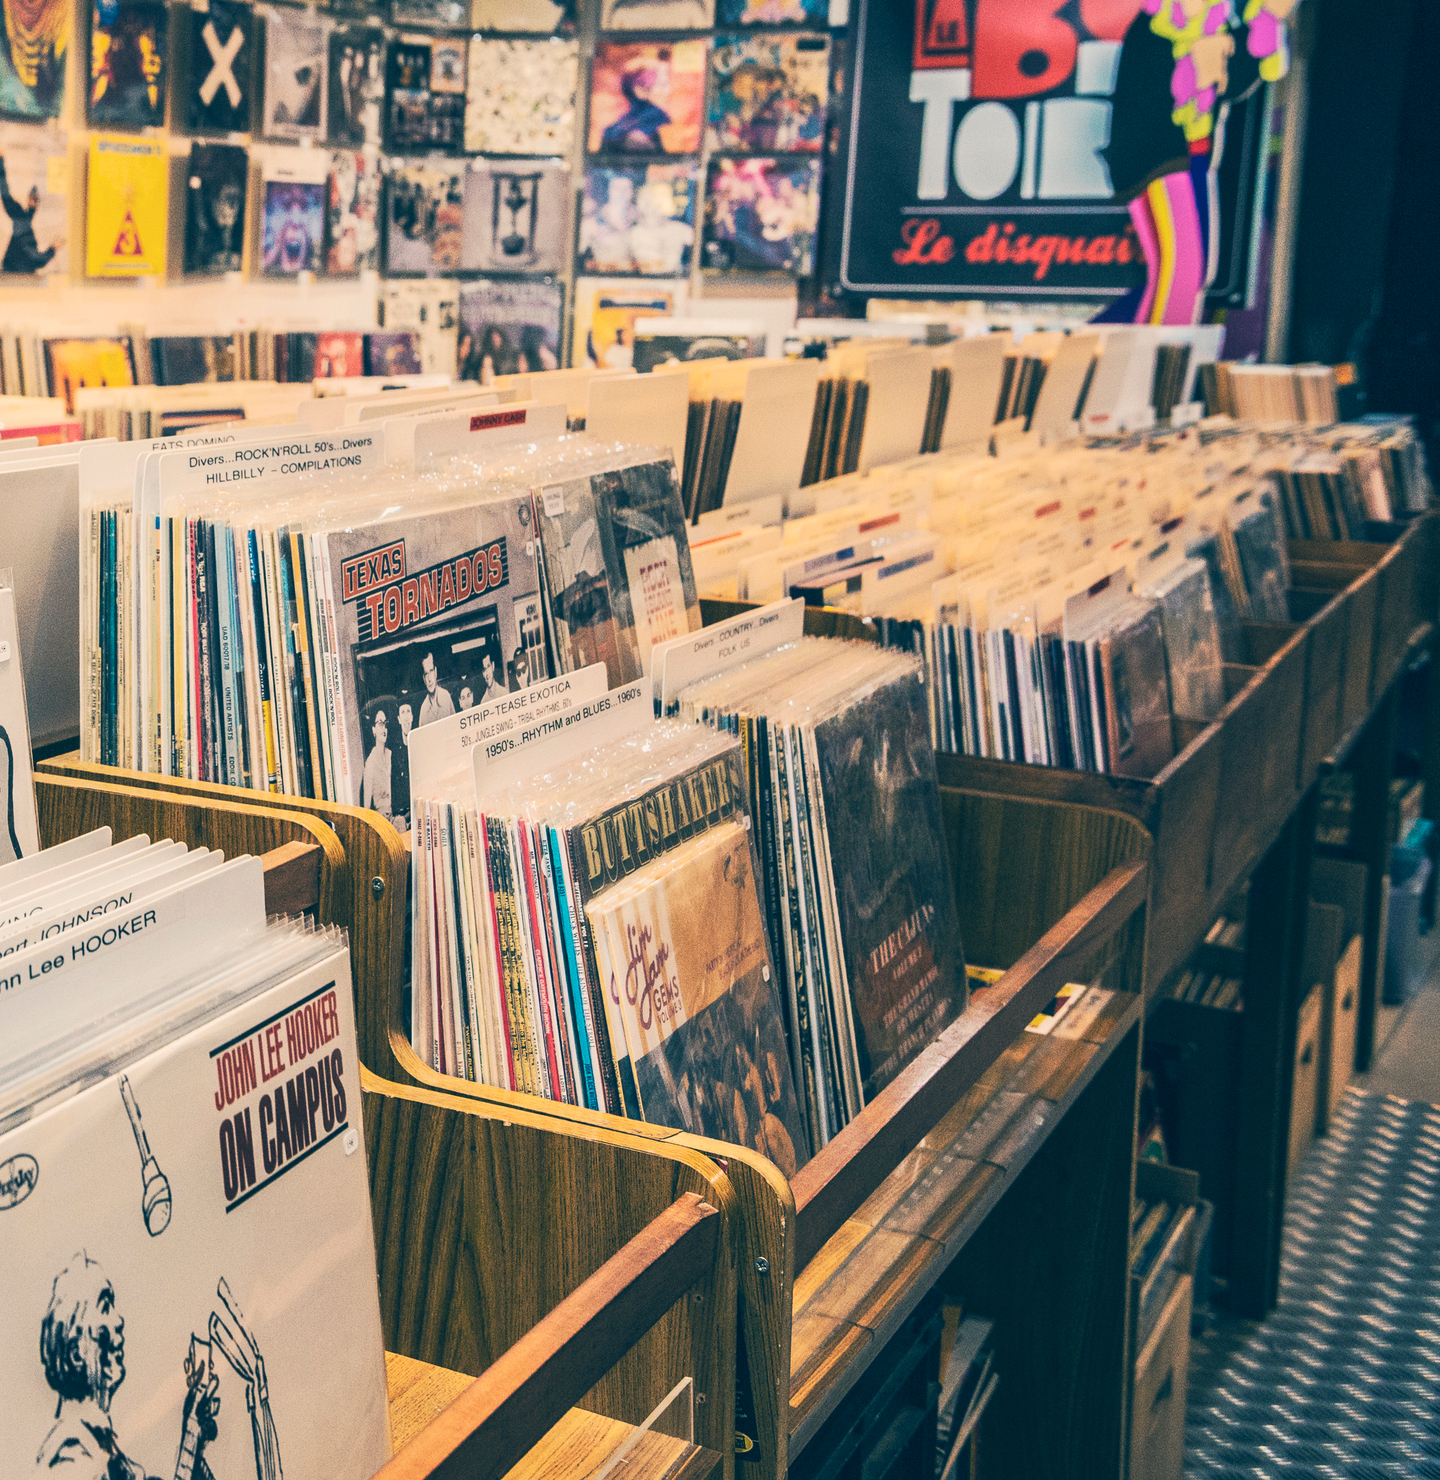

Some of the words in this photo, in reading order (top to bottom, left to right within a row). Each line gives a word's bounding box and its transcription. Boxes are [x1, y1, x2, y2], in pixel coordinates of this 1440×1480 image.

[892, 218, 955, 264] Le
[964, 222, 1140, 281] disquai
[206, 466, 265, 485] HILLBILLY
[280, 455, 362, 475] COMPILATIONS
[346, 548, 402, 595] TEXAS
[365, 543, 504, 641] TORNADOS
[221, 626, 229, 641] UAD
[324, 655, 333, 688] LOUISIANA
[225, 687, 233, 711] UNITED
[459, 694, 527, 730] STRIP-TEASE
[530, 680, 571, 704] EXOTICA
[227, 713, 235, 741] ARTISTS
[565, 710, 581, 727] and
[581, 756, 740, 893] BUTTSHAKERS
[531, 864, 540, 900] PERSONALITY
[568, 905, 579, 930] CHUCK
[28, 953, 65, 980] Lee
[71, 909, 157, 961] HOOKER
[572, 932, 582, 957] WILLIS
[539, 979, 549, 1013] GATEMOUTH
[653, 975, 680, 1012] GEMS
[543, 1013, 551, 1034] BROWN
[214, 1038, 258, 1112] JOHN
[257, 1022, 286, 1084] LEE
[285, 990, 340, 1067] HOOKER
[219, 1106, 257, 1202] ON
[258, 1047, 347, 1175] CAMPUS
